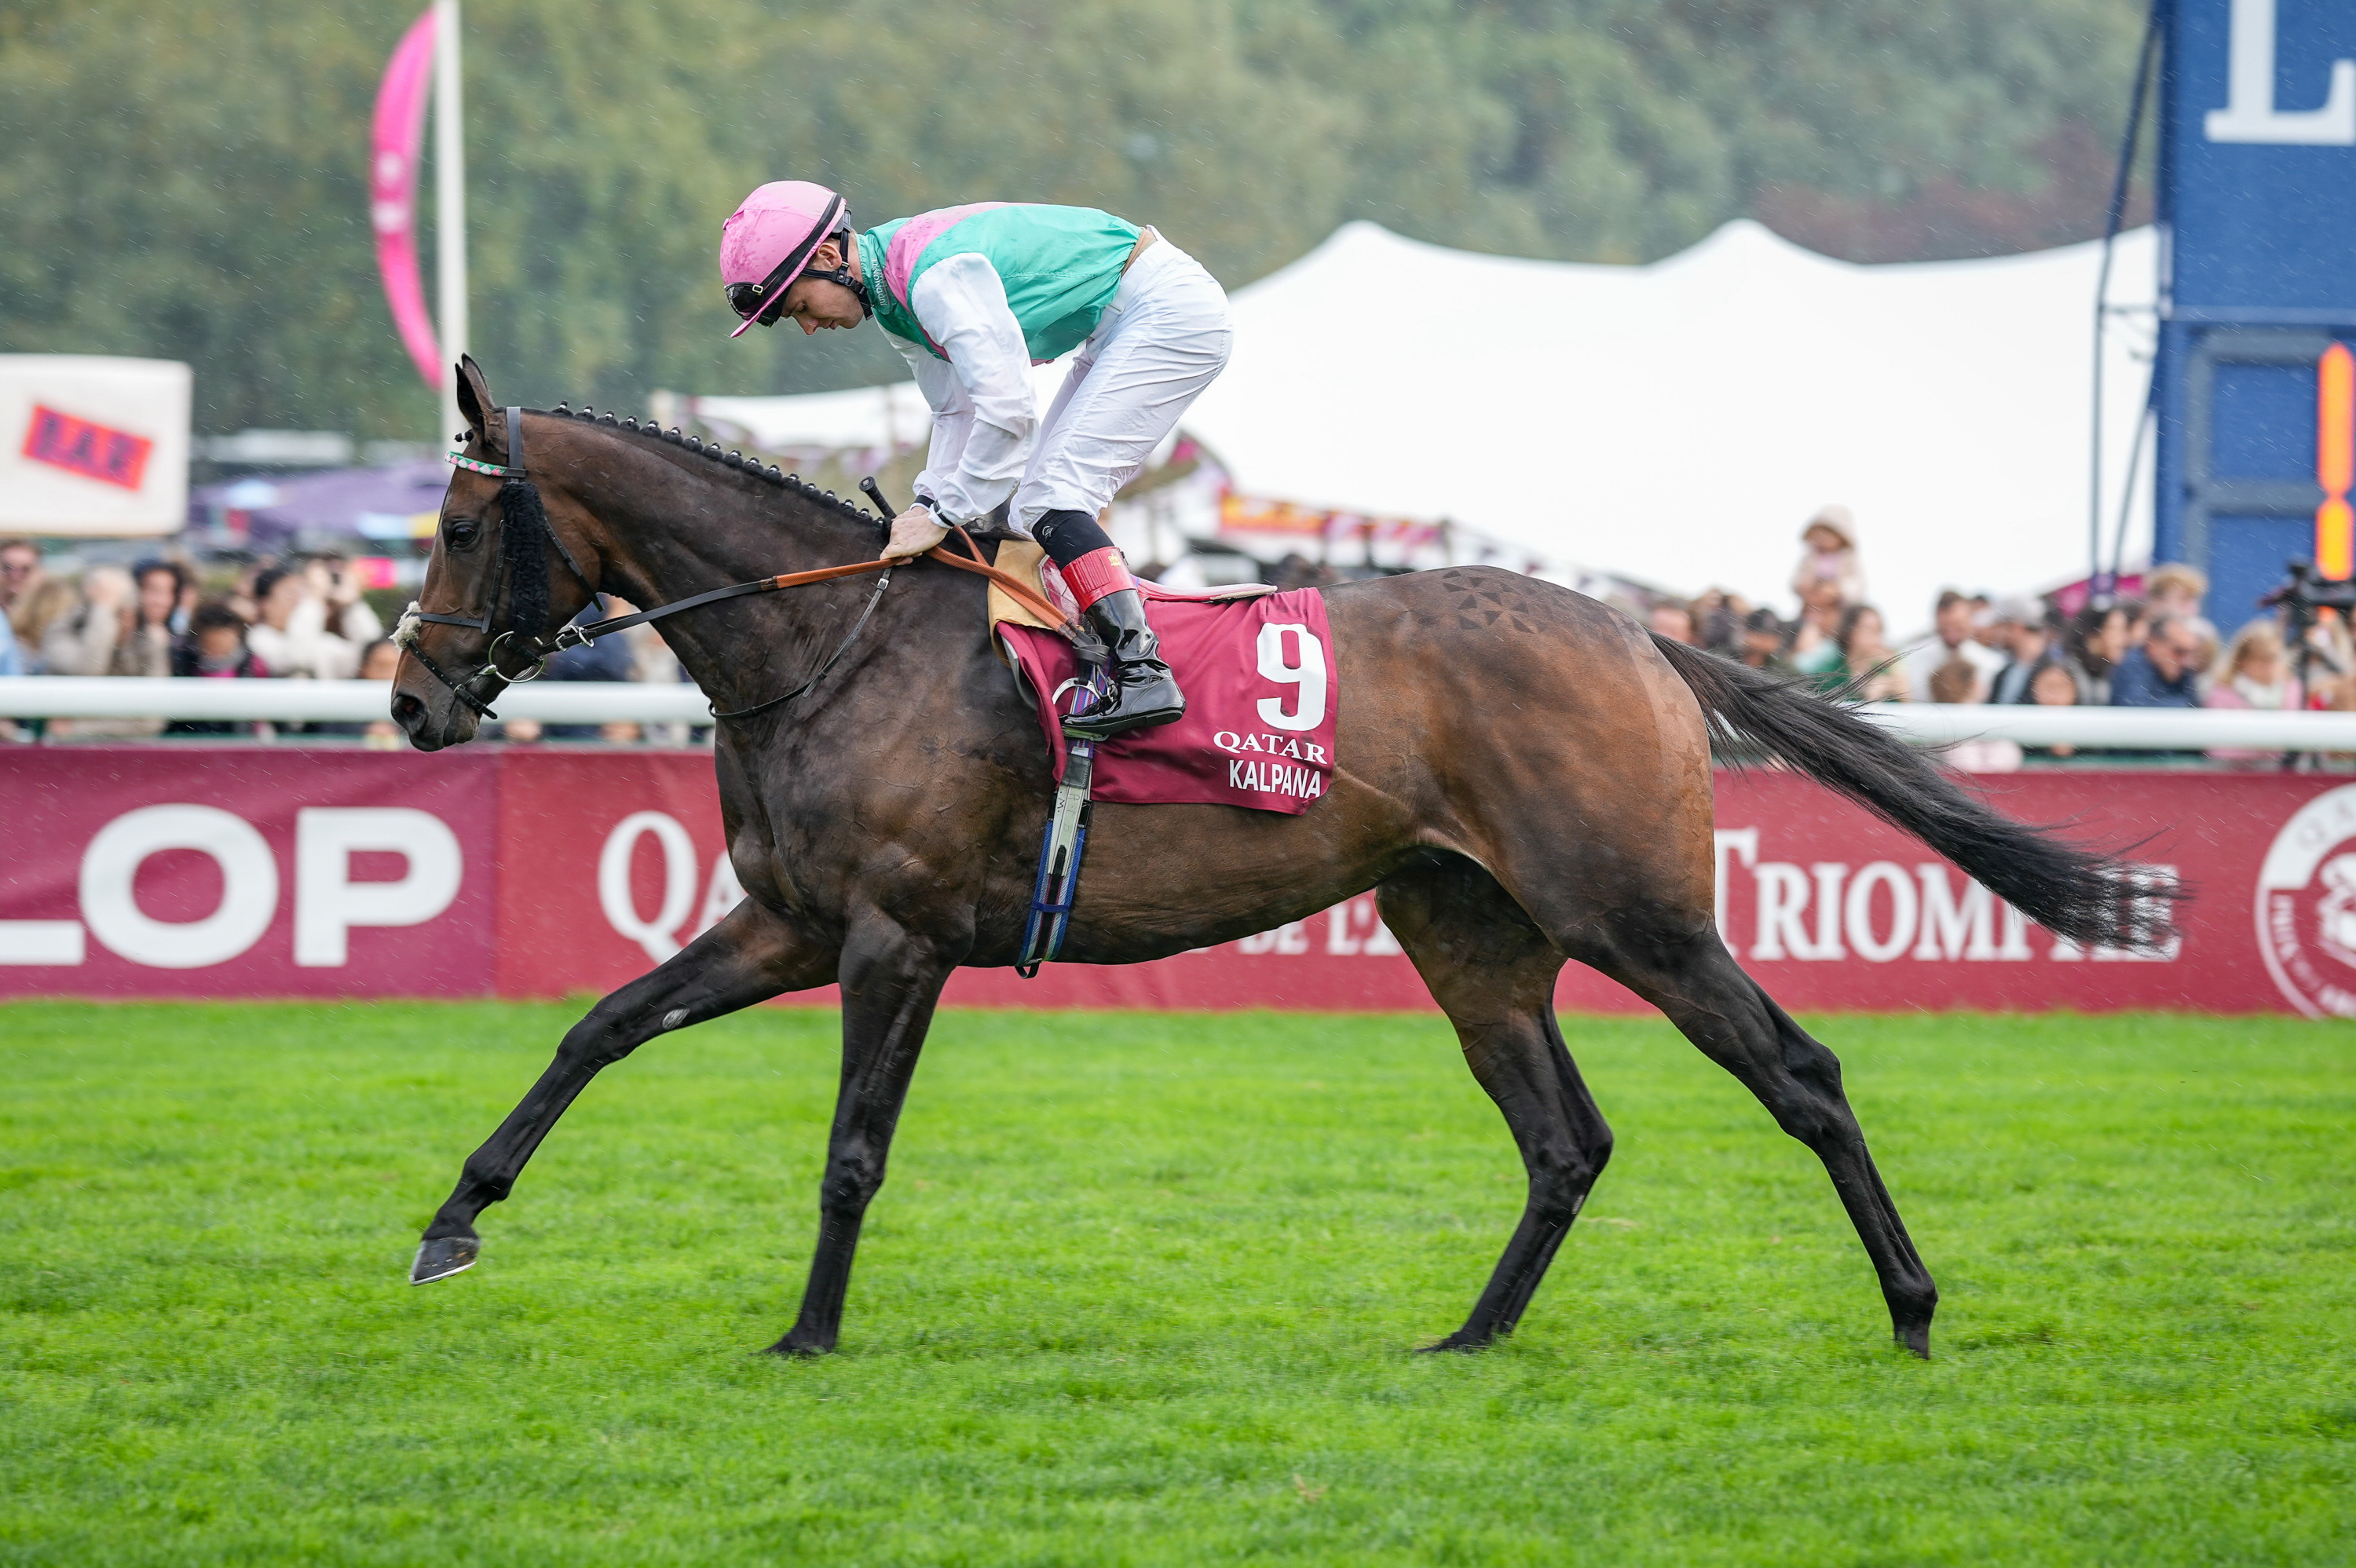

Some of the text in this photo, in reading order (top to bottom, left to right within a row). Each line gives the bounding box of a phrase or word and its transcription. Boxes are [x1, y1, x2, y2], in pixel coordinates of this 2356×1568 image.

[871, 257, 888, 306] JUDDMONTE
[1257, 623, 1328, 732] 9
[1213, 731, 1328, 764] QATAR
[1229, 759, 1321, 799] KALPANA
[1714, 824, 2182, 963] TRIOME
